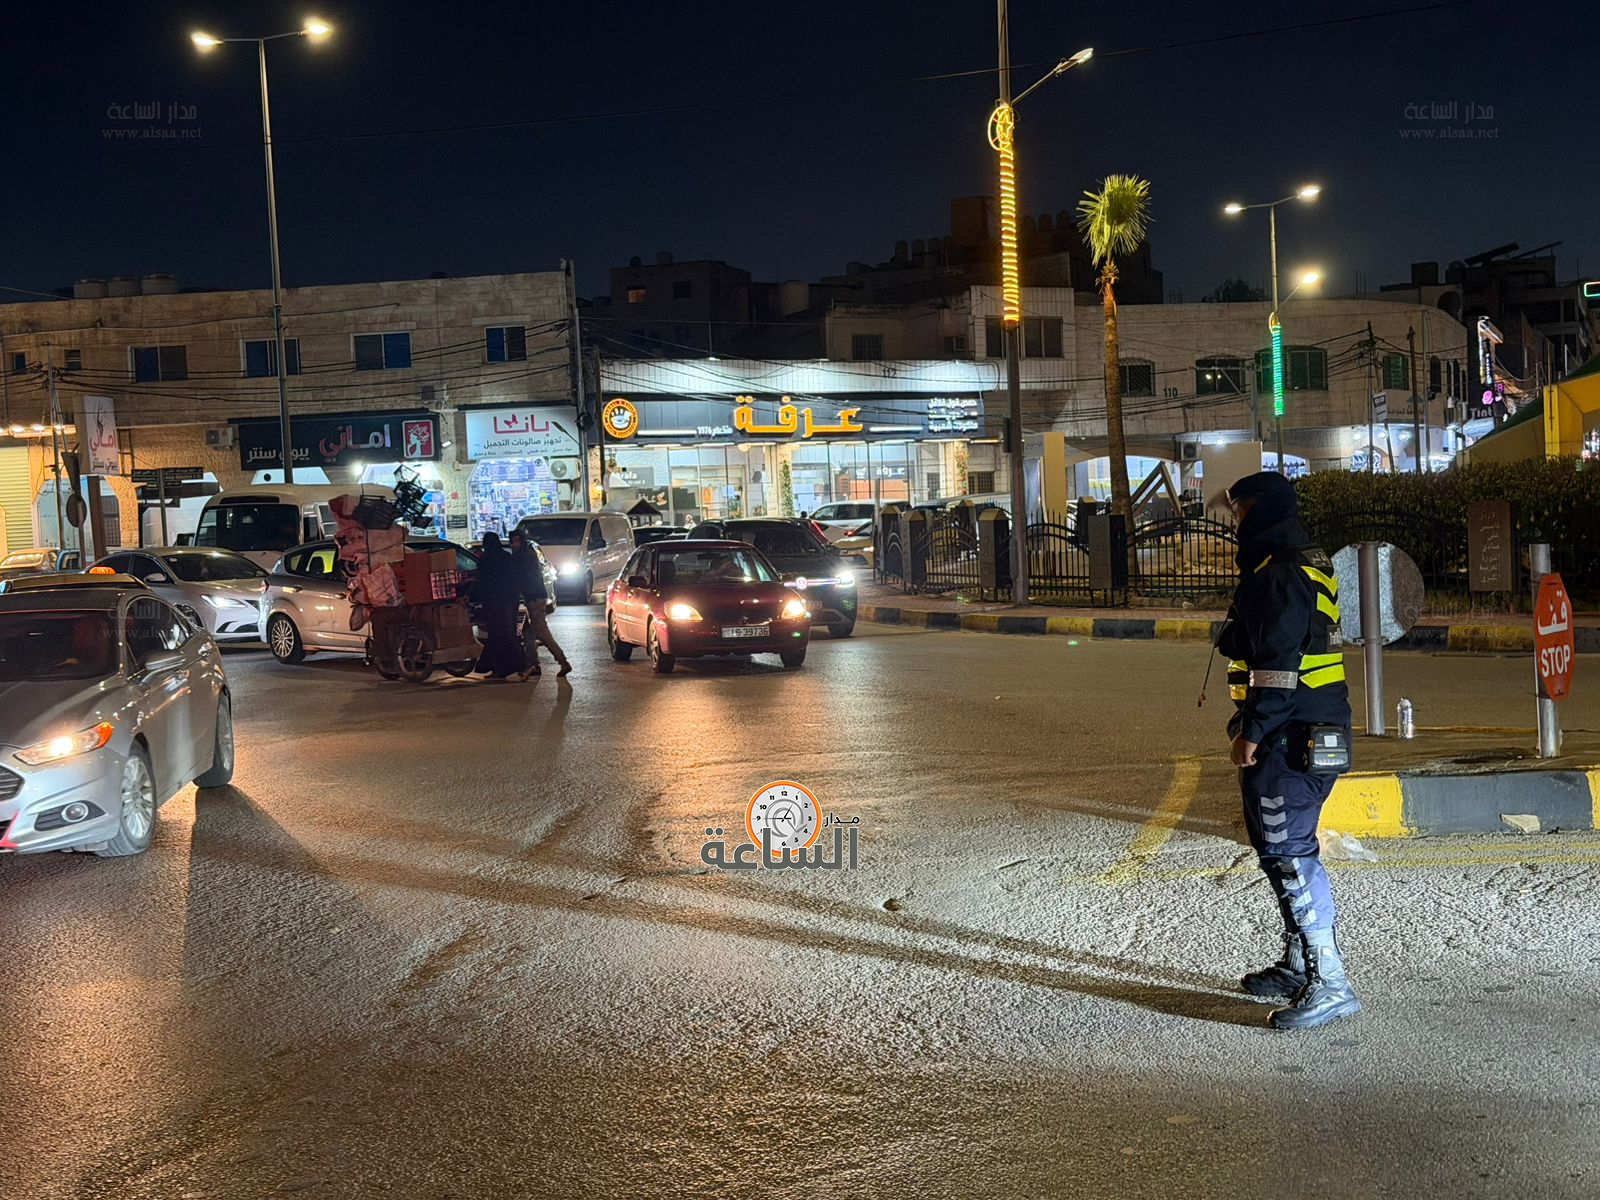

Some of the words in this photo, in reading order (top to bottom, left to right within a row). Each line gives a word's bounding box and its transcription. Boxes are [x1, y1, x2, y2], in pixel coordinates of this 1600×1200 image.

[1163, 386, 1178, 398] 110
[733, 395, 864, 438] عرفة
[246, 447, 277, 463] سنتر
[1538, 590, 1568, 636] قف
[1541, 644, 1571, 678] STOP
